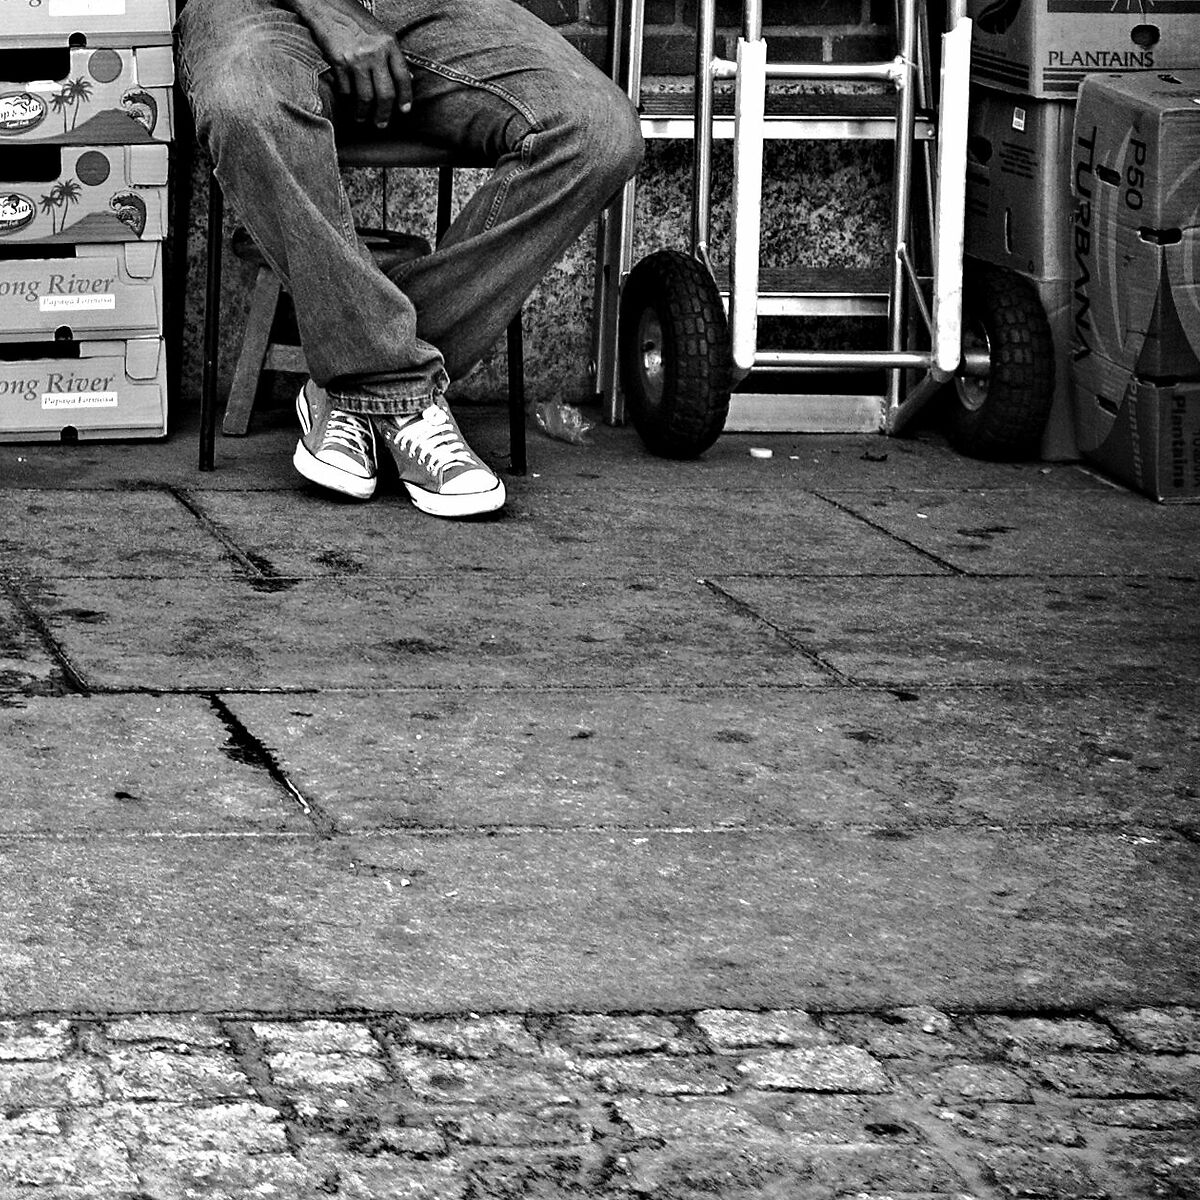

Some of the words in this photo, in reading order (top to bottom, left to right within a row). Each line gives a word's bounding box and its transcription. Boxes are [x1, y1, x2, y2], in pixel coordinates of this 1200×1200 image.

[1050, 51, 1154, 67] PLANTAINS
[1125, 138, 1147, 210] P50
[1073, 126, 1098, 362] TURBANA
[48, 274, 115, 294] River
[46, 373, 114, 393] River
[1173, 394, 1187, 488] Plantains
